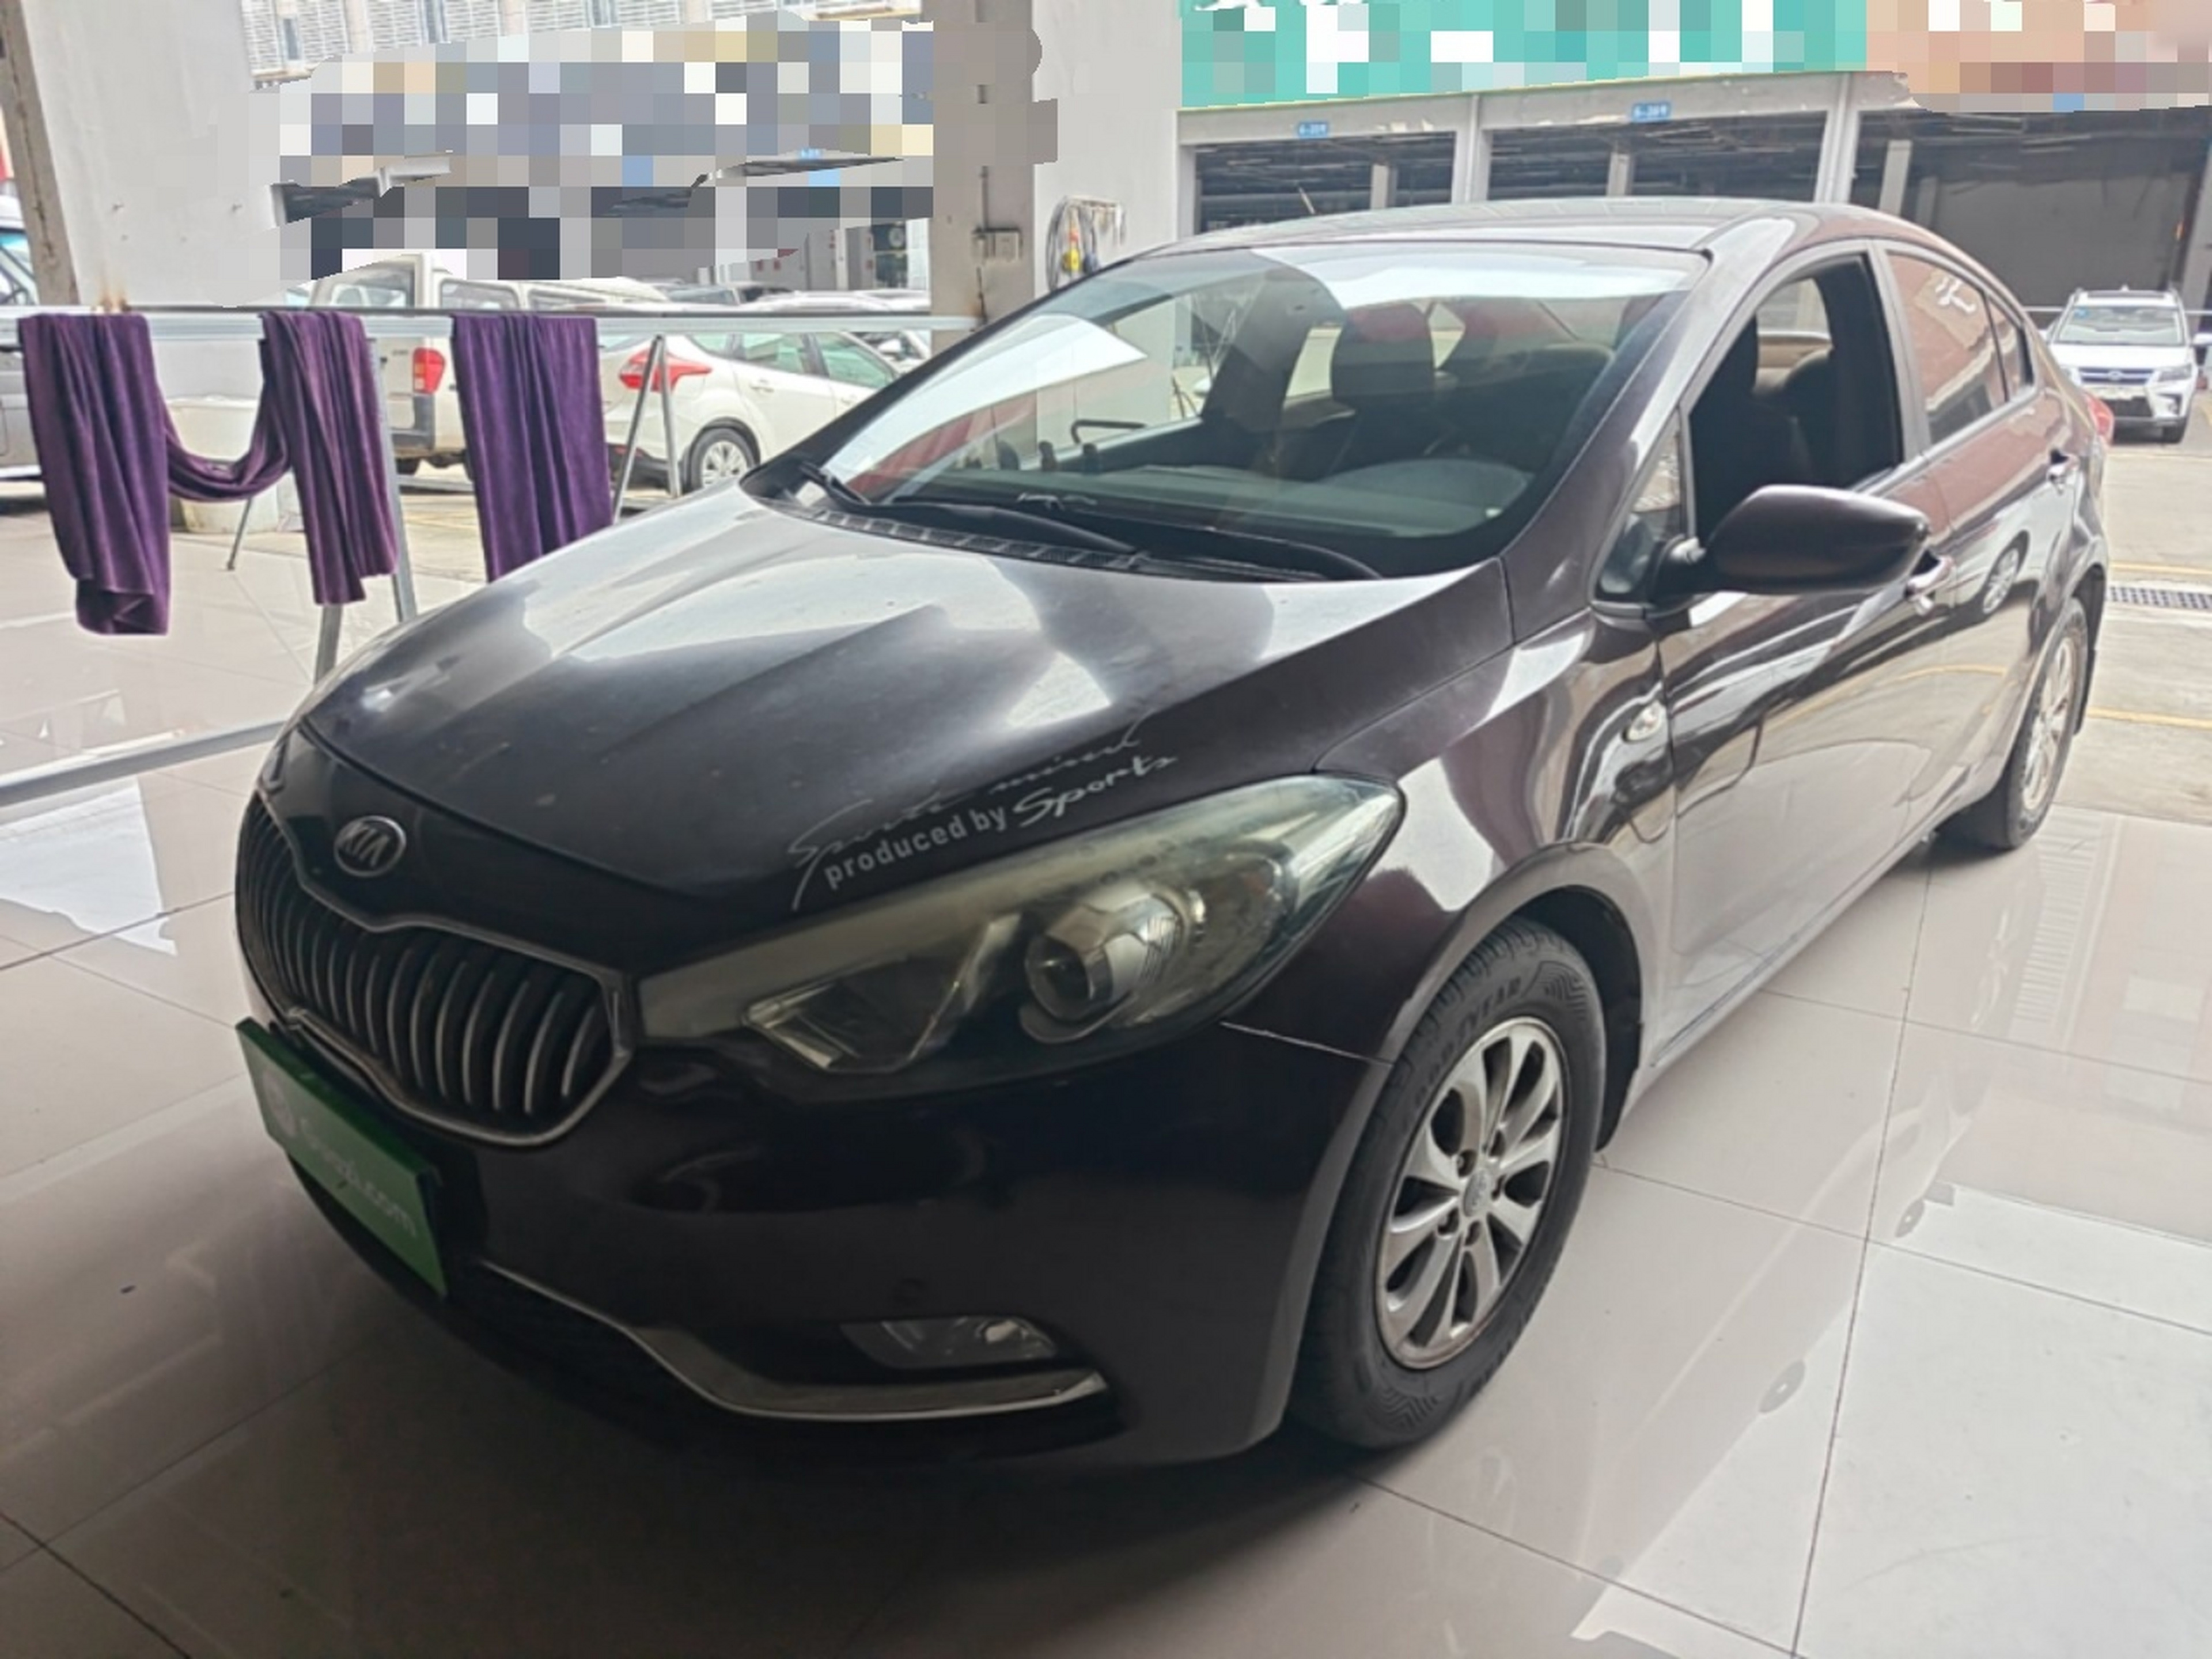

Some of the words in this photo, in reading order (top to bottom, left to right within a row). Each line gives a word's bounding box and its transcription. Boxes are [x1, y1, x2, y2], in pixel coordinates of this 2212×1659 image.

[824, 814, 968, 891] produced
[968, 806, 1006, 831] by
[1012, 755, 1179, 828] Sports
